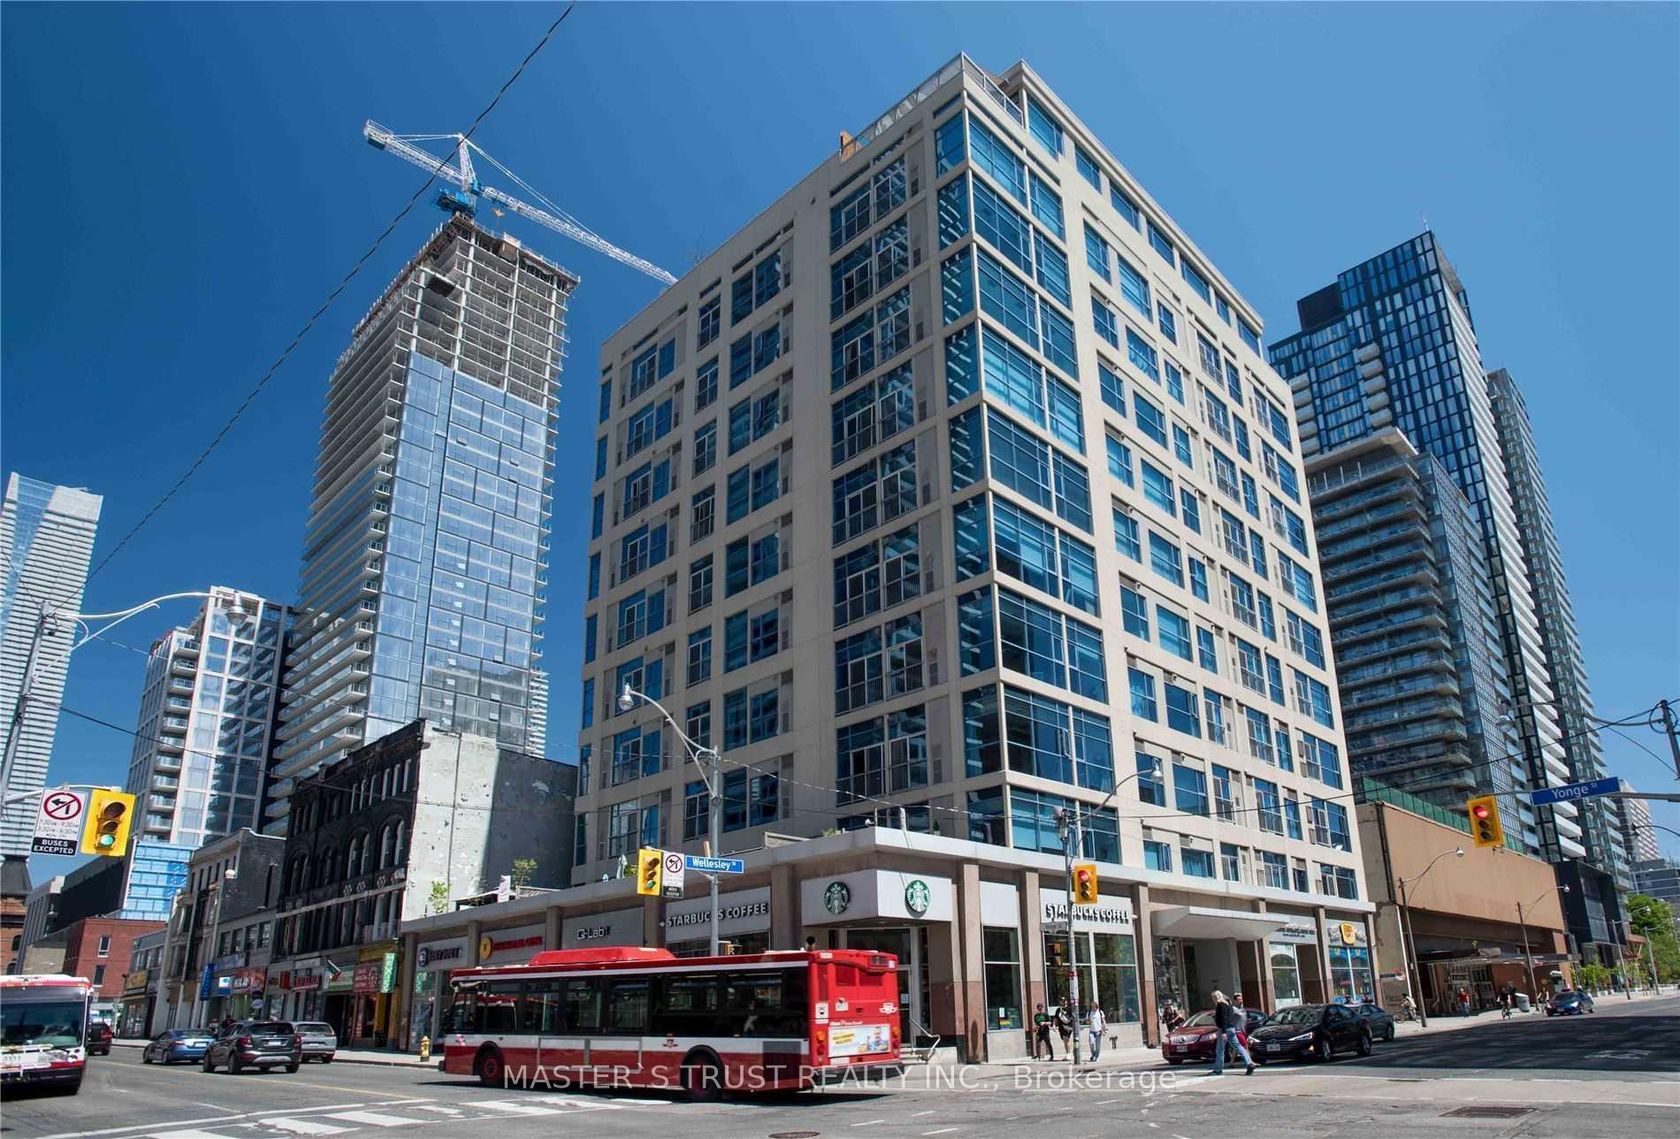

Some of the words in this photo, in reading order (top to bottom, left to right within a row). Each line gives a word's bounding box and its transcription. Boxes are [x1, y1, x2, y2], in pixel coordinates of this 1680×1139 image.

[1551, 785, 1589, 799] Yonge
[33, 844, 74, 854] EXCEPTED
[42, 839, 69, 847] BUSES
[692, 856, 731, 871] Wellesley
[667, 909, 725, 927] STARBUCS
[727, 903, 768, 919] COFFEE
